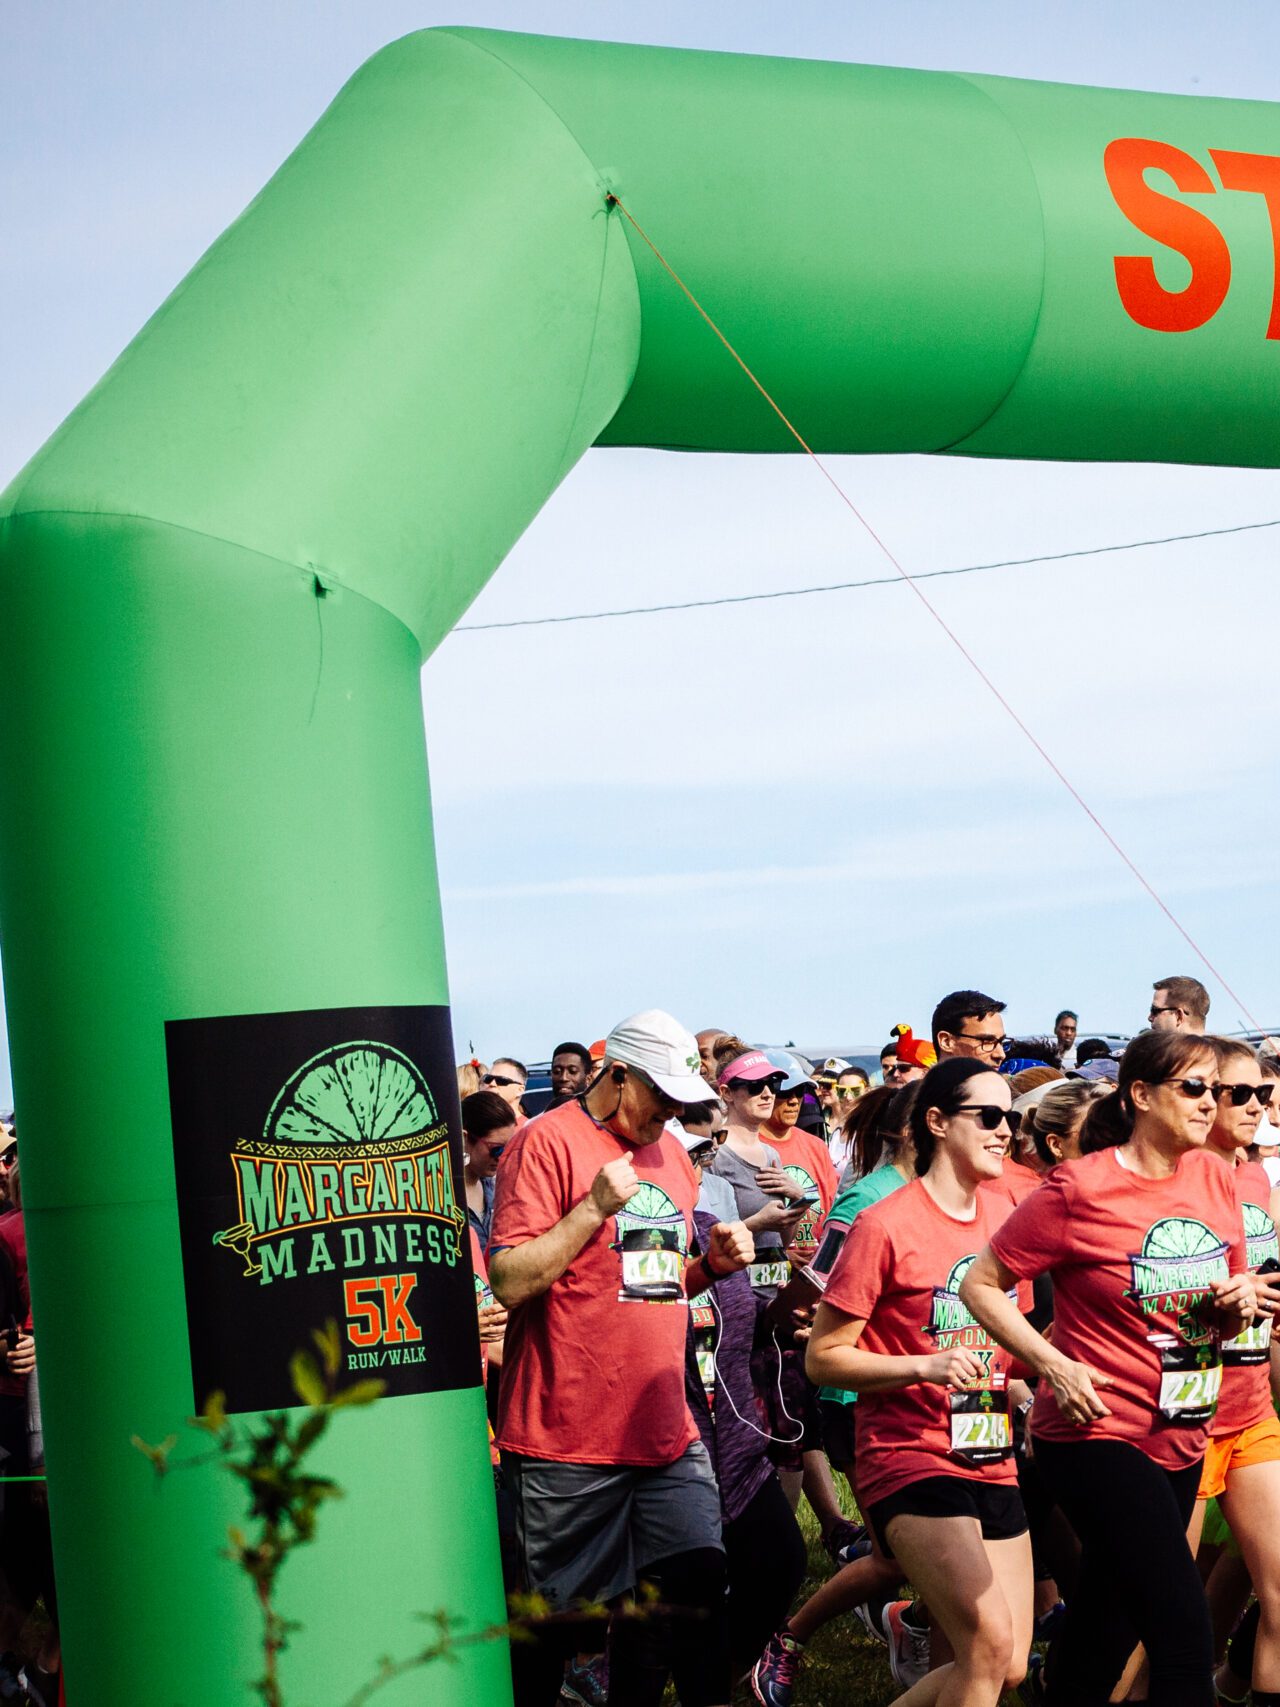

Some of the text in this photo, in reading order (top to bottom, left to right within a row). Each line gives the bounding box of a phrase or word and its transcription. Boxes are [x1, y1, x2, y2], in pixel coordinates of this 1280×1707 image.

[238, 1143, 457, 1236] MARGARITA
[257, 1223, 457, 1286] MADNESS
[760, 1262, 788, 1286] 826
[343, 1272, 423, 1348] 5K
[348, 1346, 427, 1371] RUN/WALK
[957, 1414, 1007, 1449] 2245
